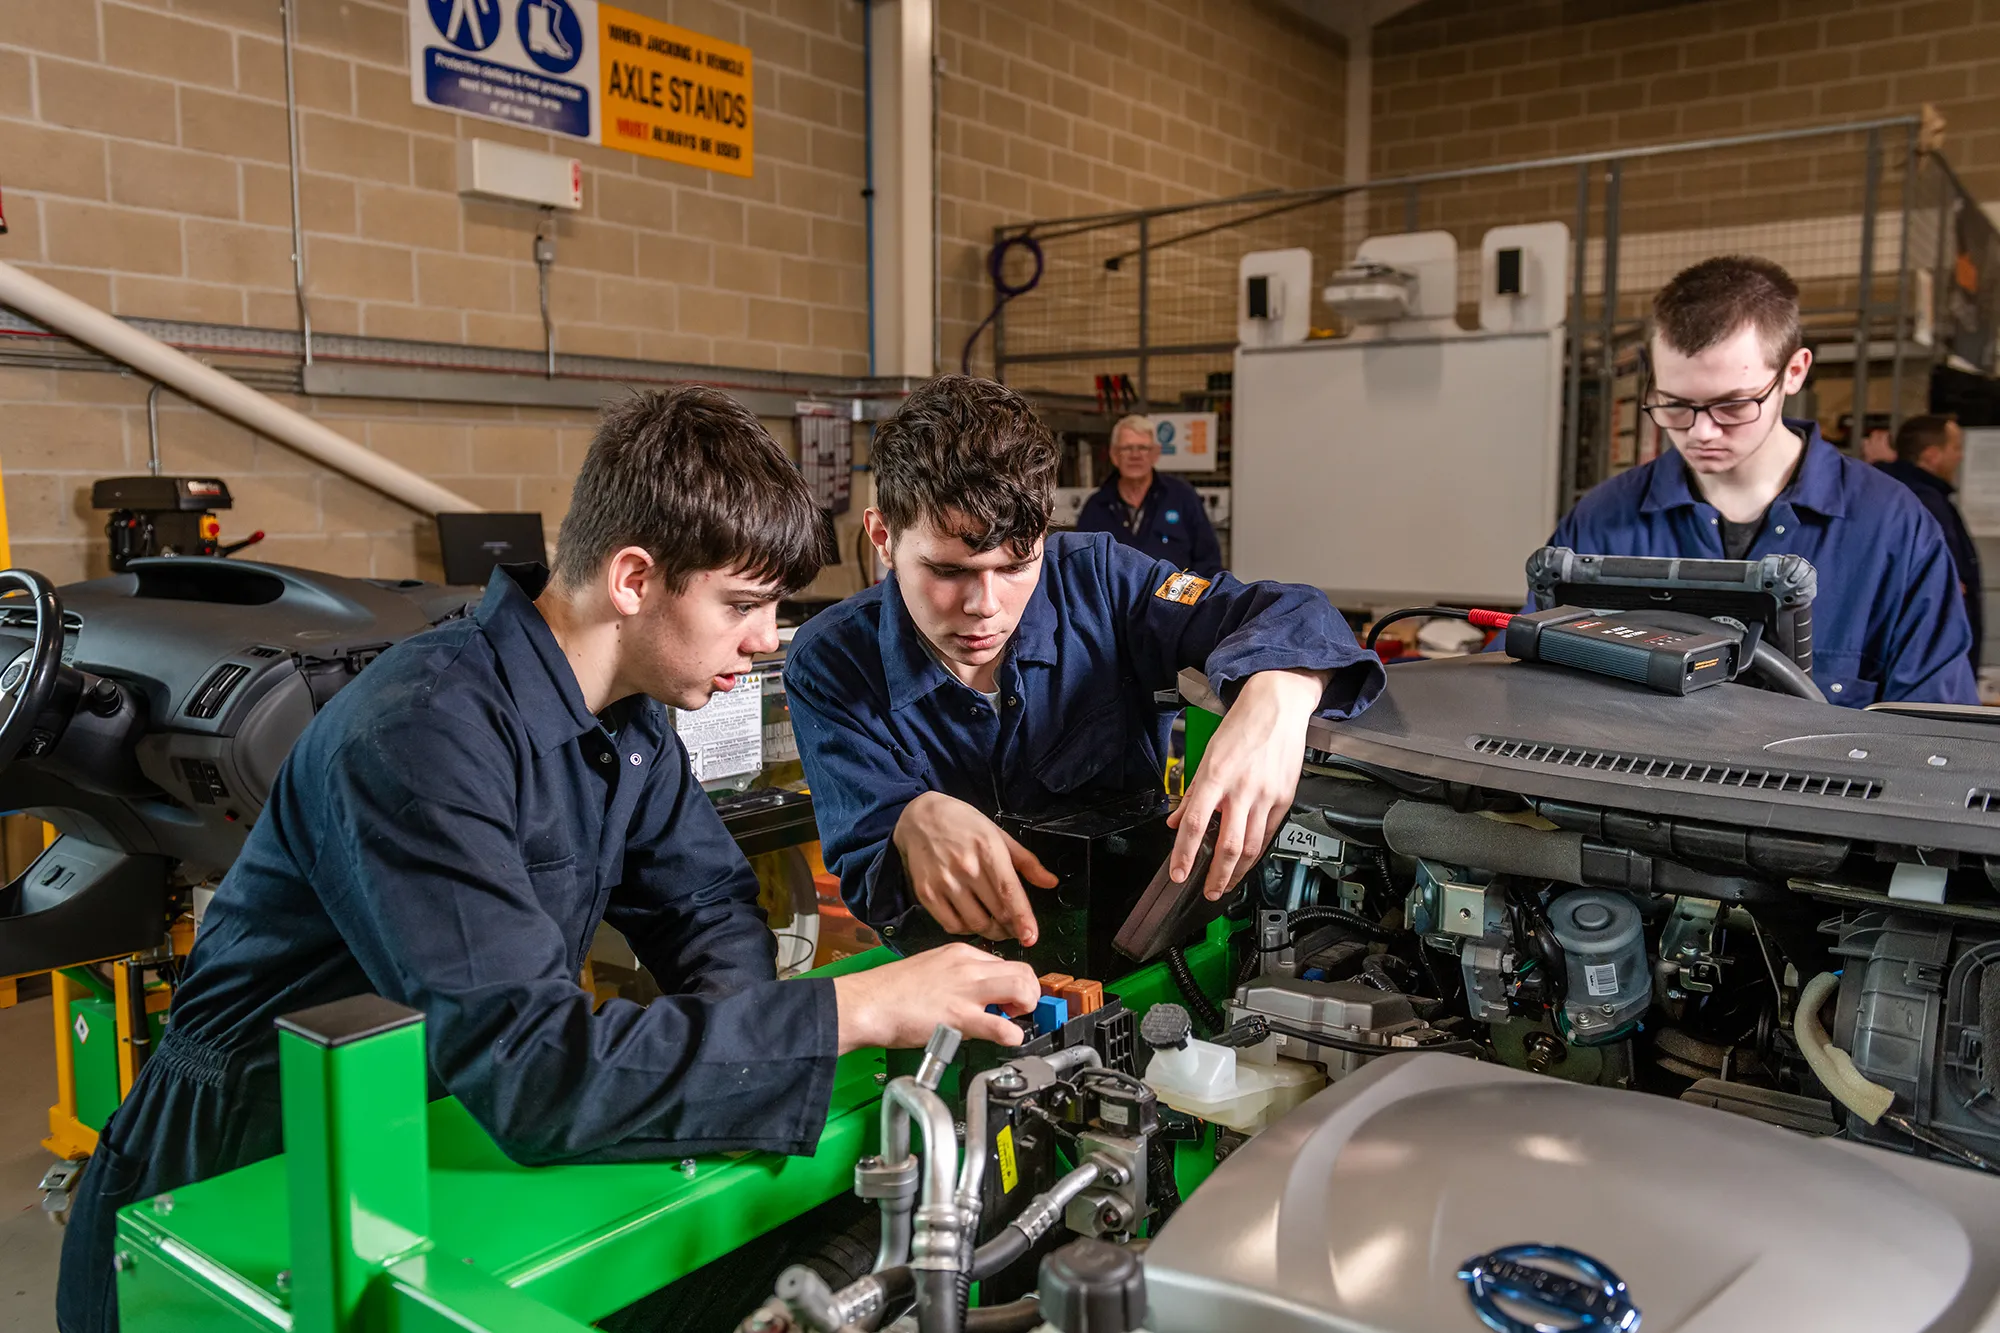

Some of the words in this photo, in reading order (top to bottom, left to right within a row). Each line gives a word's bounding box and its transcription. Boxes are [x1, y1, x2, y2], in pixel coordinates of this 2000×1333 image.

[608, 22, 642, 48] WHEN
[647, 34, 693, 62] JACKING
[608, 59, 664, 109] AXLE
[668, 76, 747, 129] STANDS
[653, 125, 697, 151] ALWAYS
[699, 136, 713, 154] BE
[1286, 830, 1317, 848] 4291
